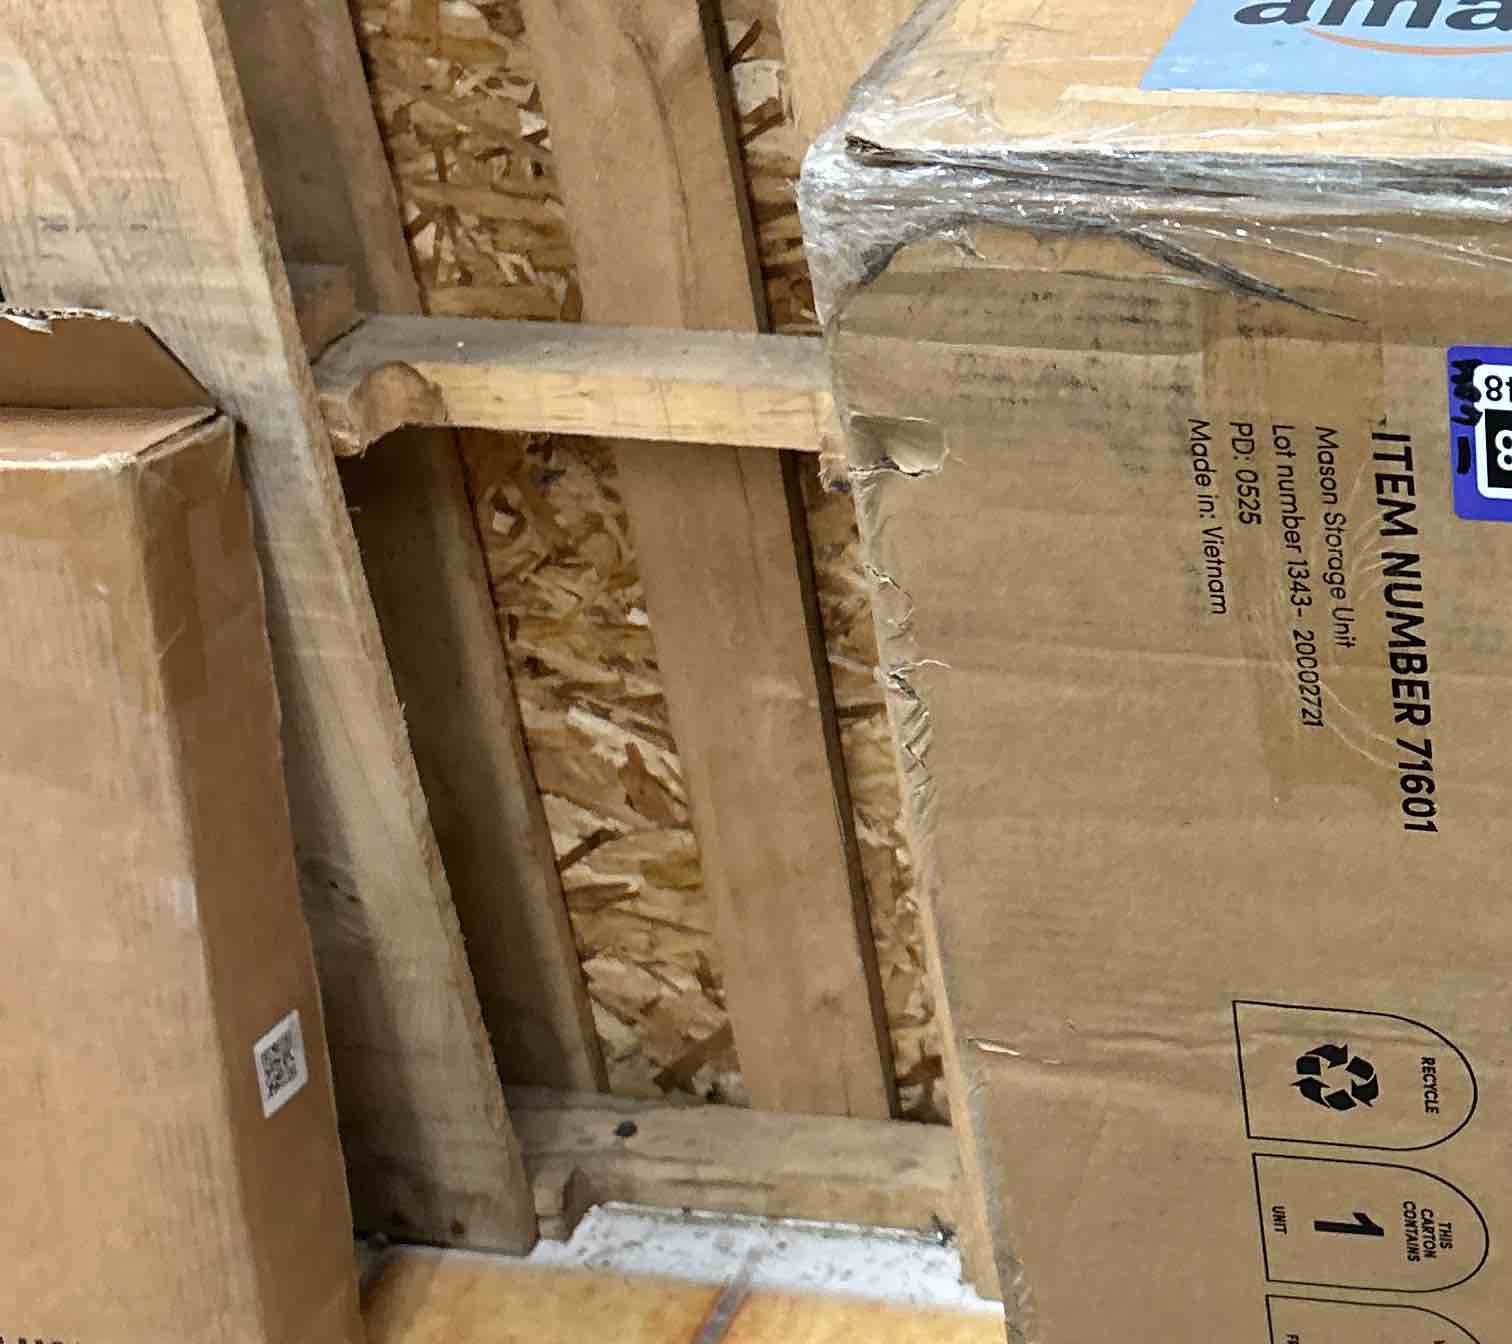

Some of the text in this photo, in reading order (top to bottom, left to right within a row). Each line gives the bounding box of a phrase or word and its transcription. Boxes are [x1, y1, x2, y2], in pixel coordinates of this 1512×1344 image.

[1272, 424, 1296, 457] Lot
[1230, 422, 1261, 525] PD: 0525
[1188, 419, 1229, 614] Made in: Vietnam
[1276, 465, 1304, 552] number
[1315, 426, 1356, 648] Mason Storage Unit
[1372, 432, 1438, 833] ITEM NUMBER 71601
[1293, 630, 1323, 727] 20002721
[1422, 1056, 1439, 1113] RECYCLE
[1272, 1205, 1287, 1235] UNIT
[1314, 1212, 1385, 1236] 1
[1403, 1201, 1420, 1262] CONTAINS
[1421, 1209, 1436, 1258] CARTON
[1439, 1223, 1453, 1249] THIS
